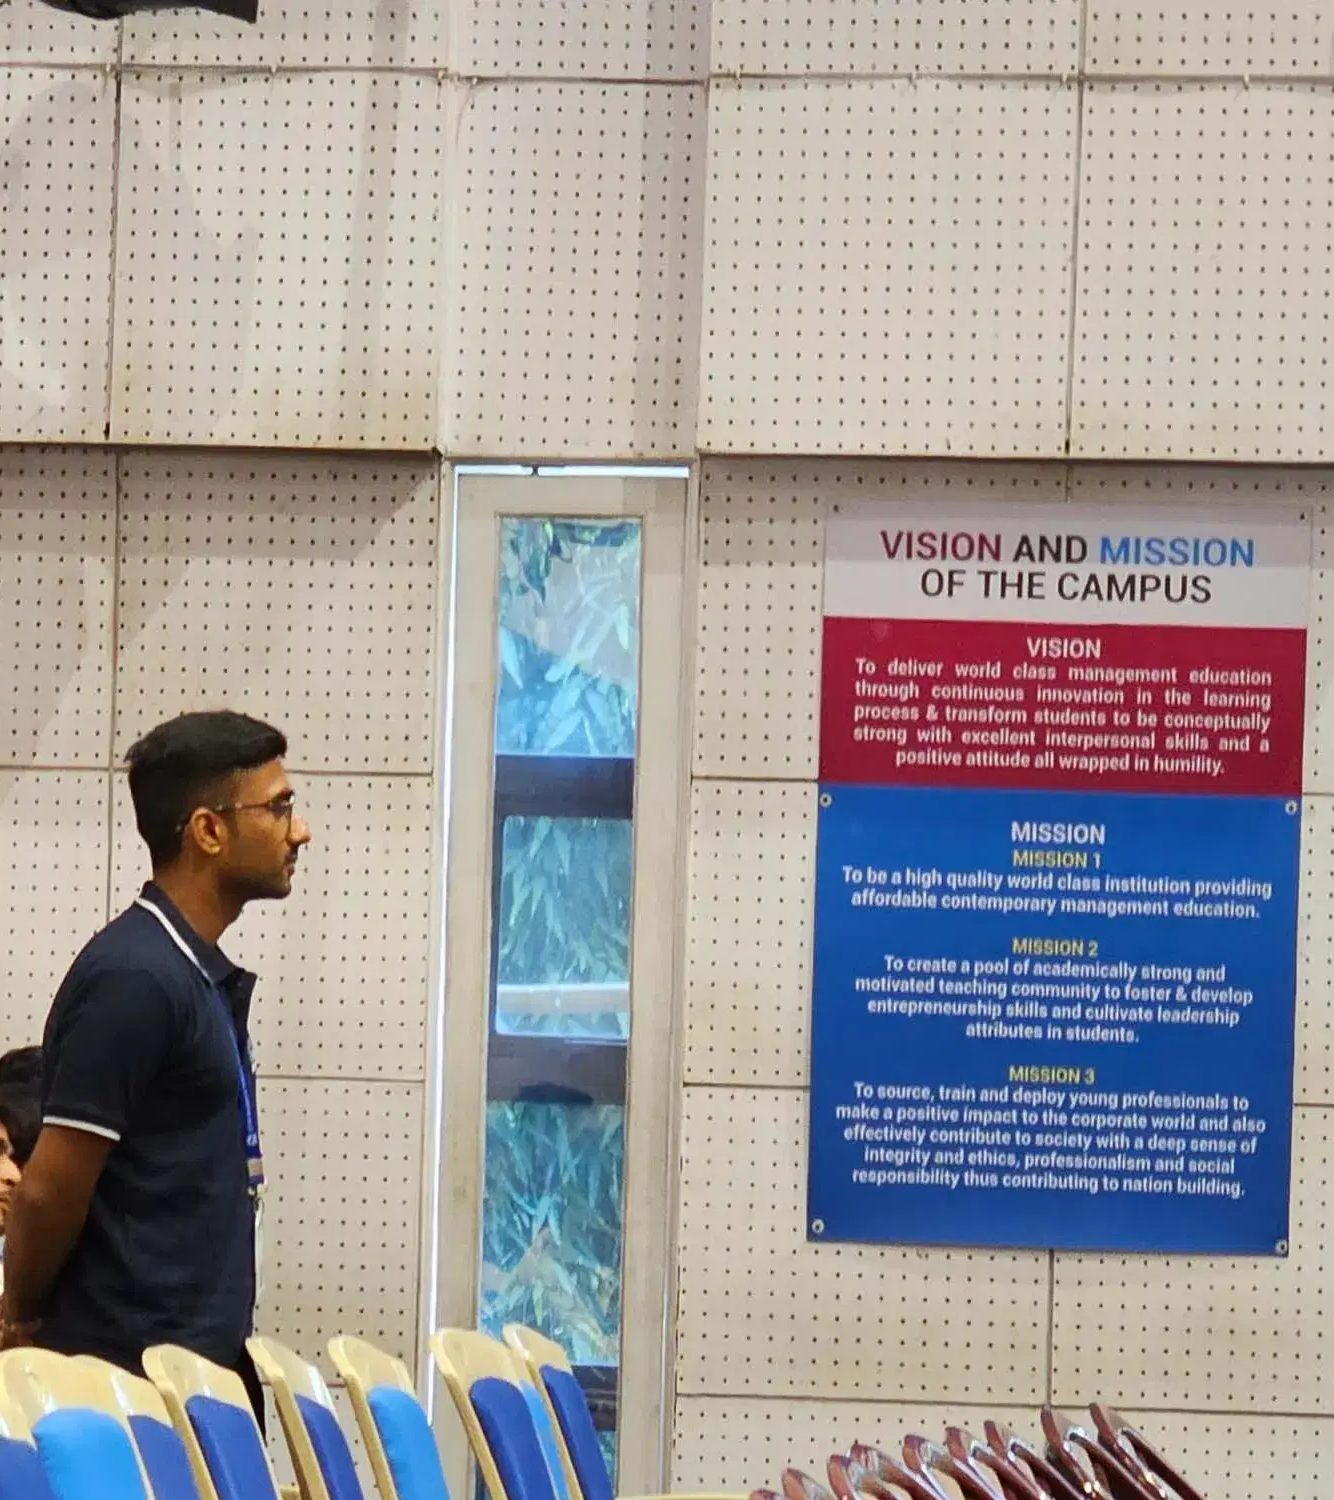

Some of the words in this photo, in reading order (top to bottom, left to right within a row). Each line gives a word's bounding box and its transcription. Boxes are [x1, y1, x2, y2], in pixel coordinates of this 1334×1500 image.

[880, 530, 1000, 562] VISION
[1012, 534, 1087, 563] AND
[1100, 536, 1253, 567] MISSION
[921, 568, 966, 597] OF
[977, 570, 1045, 599] THE
[1057, 572, 1211, 603] CAMPUS
[1027, 637, 1100, 658] VISION
[856, 657, 876, 674] To
[887, 657, 943, 676] deliver
[955, 660, 1000, 678] world
[1012, 661, 1056, 680] class
[1068, 666, 1177, 685] management
[1189, 666, 1271, 685] education
[855, 678, 919, 702] through
[931, 682, 1024, 701] continuous
[1036, 683, 1124, 704] innovation
[1136, 687, 1151, 704] in
[1164, 687, 1191, 705] the
[1203, 688, 1271, 712] learning
[854, 704, 919, 722] process
[925, 703, 938, 721] &
[944, 704, 1027, 723] transform
[1033, 707, 1106, 725] students
[1113, 710, 1130, 725] to
[1136, 708, 1157, 726] be
[1164, 711, 1270, 733] conceptually
[853, 725, 907, 745] strong
[917, 725, 951, 742] with
[961, 727, 1035, 745] excellent
[1045, 729, 1155, 750] interpersonal
[1165, 732, 1208, 750] skills
[1218, 734, 1249, 751] and
[1259, 738, 1269, 752] a
[895, 747, 961, 766] positive
[965, 749, 1030, 767] attitude
[1034, 750, 1054, 768] all
[1058, 752, 1129, 773] wrapped
[1134, 753, 1149, 771] in
[1011, 820, 1104, 844] MISSION
[1012, 849, 1087, 868] MISSION
[1093, 852, 1100, 868] 1
[842, 865, 862, 883] To
[866, 866, 887, 884] be
[890, 871, 901, 884] a
[905, 867, 942, 889] high
[946, 870, 1003, 891] quality
[1007, 871, 1053, 889] world
[1056, 872, 1100, 891] class
[1104, 874, 1190, 894] institution
[1194, 878, 1271, 900] providing
[850, 888, 937, 908] affordable
[940, 892, 1056, 915] contemporary
[1060, 898, 1168, 917] management
[1012, 937, 1083, 956] MISSION
[1088, 940, 1097, 956] 2
[884, 954, 903, 971] To
[906, 957, 956, 972] create
[960, 960, 970, 973] a
[973, 957, 1008, 976] pool
[1012, 958, 1029, 975] of
[1032, 959, 1136, 980] academically
[1141, 964, 1191, 984] strong
[1195, 964, 1225, 981] and
[855, 975, 934, 993] motivated
[938, 977, 1007, 999] teaching
[1011, 982, 1100, 1002] community
[1104, 983, 1120, 999] to
[1124, 984, 1171, 1001] foster
[1175, 985, 1187, 1001] &
[1191, 985, 1253, 1006] develop
[867, 997, 1001, 1020] entrepreneurship
[1005, 1000, 1047, 1018] skills
[1051, 1002, 1081, 1019] and
[1084, 1003, 1153, 1021] cultivate
[1157, 1005, 1239, 1027] leadership
[965, 1020, 1042, 1039] attributes
[1046, 1023, 1062, 1040] in
[1009, 1065, 1080, 1084] MISSION
[1084, 1068, 1094, 1084] 3
[853, 1081, 873, 1098] To
[938, 1084, 975, 1101] train
[979, 1085, 1008, 1102] and
[1012, 1085, 1065, 1108] deploy
[1069, 1091, 1118, 1109] young
[1122, 1090, 1228, 1110] professionals
[1232, 1095, 1248, 1110] to
[835, 1102, 879, 1121] make
[882, 1107, 892, 1122] a
[896, 1104, 959, 1123] positive
[963, 1106, 1017, 1126] impact
[1021, 1109, 1038, 1124] to
[1041, 1108, 1067, 1125] the
[1071, 1112, 1147, 1130] corporate
[1151, 1112, 1195, 1130] world
[1199, 1114, 1228, 1131] and
[1232, 1114, 1265, 1132] also
[843, 1122, 926, 1145] effectively
[929, 1126, 1011, 1145] contribute
[1015, 1130, 1031, 1145] to
[1035, 1131, 1092, 1151] society
[1095, 1131, 1129, 1149] with
[1134, 1136, 1143, 1149] a
[1147, 1132, 1186, 1155] deep
[1190, 1138, 1236, 1152] sense
[1240, 1136, 1256, 1153] of
[864, 1145, 931, 1167] integrity
[934, 1147, 964, 1164] and
[1024, 1150, 1151, 1171] professionalism
[1154, 1155, 1184, 1172] and
[1188, 1157, 1234, 1173] social
[852, 1167, 960, 1188] responsibility
[963, 1169, 998, 1186] thus
[1002, 1171, 1098, 1191] contributing
[1102, 1175, 1119, 1191] to
[1122, 1175, 1172, 1192] nation
